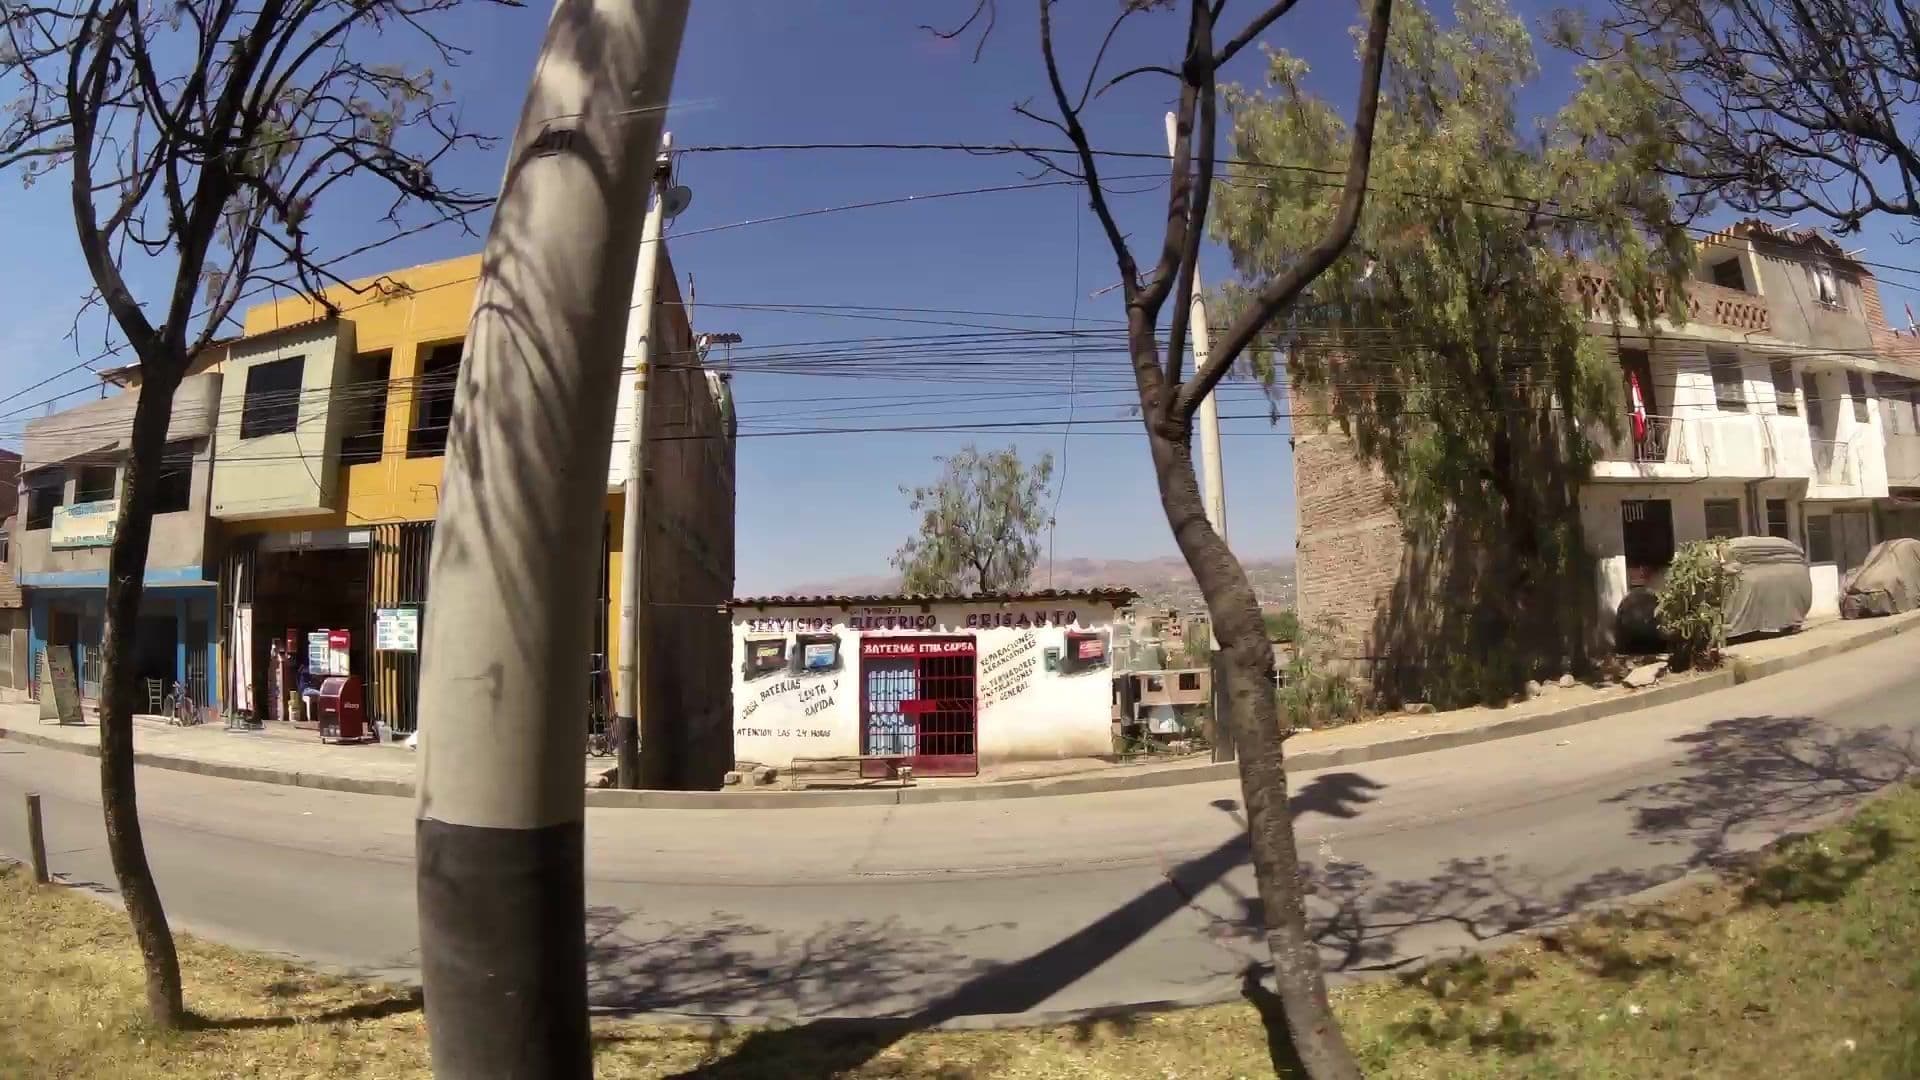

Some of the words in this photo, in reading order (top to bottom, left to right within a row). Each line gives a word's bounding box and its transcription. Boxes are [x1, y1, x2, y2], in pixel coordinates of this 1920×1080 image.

[750, 617, 833, 632] SERVICIOS
[849, 616, 937, 631] ELECTRICO
[966, 610, 1077, 626] CRISANTO
[864, 644, 915, 654] BATERIAS
[944, 642, 974, 651] CAPSA
[980, 631, 1034, 666] REPARACIONES
[760, 679, 801, 702] BATERIAS
[805, 696, 835, 716] RAPIDA
[737, 728, 772, 737] ATENCION
[777, 729, 790, 737] LAS
[797, 729, 807, 737] 24
